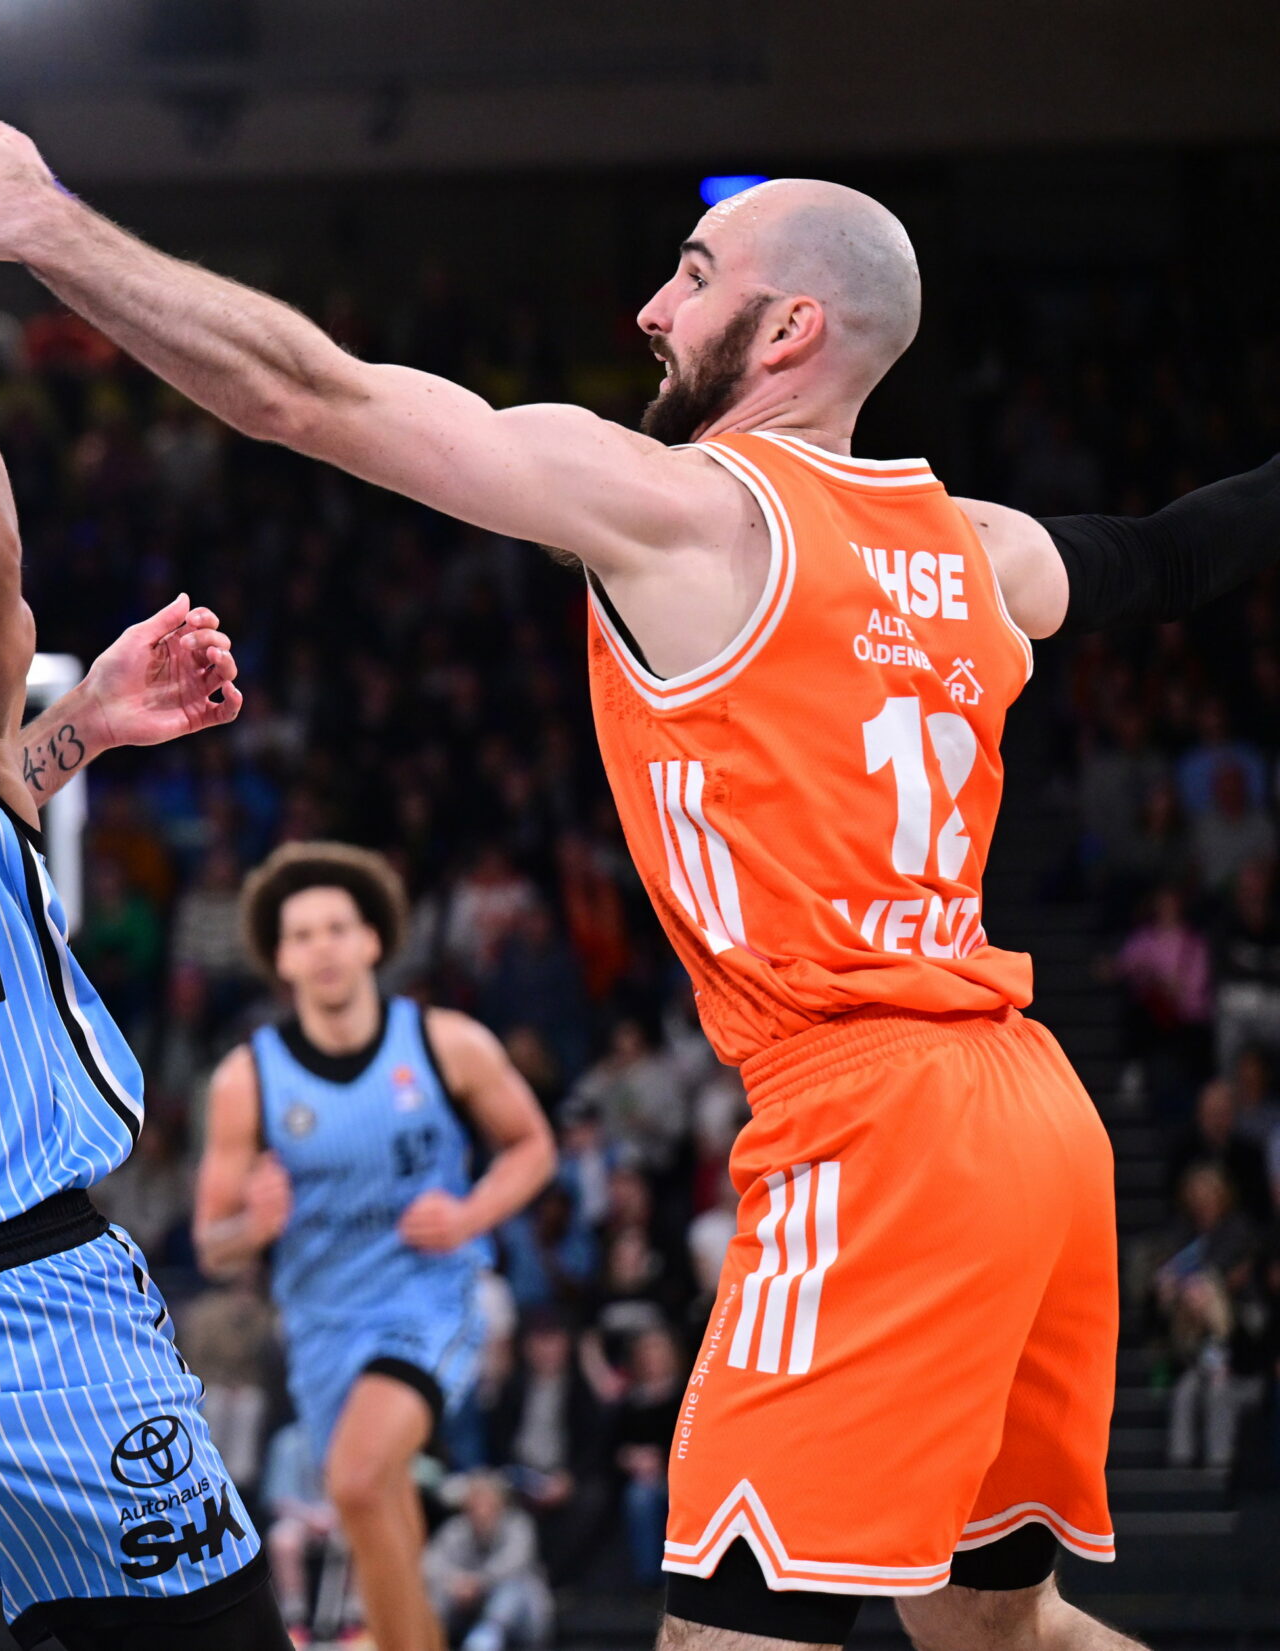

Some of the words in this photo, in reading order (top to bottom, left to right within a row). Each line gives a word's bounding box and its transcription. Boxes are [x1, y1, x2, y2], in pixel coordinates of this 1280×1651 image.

[862, 696, 977, 881] 12
[677, 1392, 700, 1460] meine
[119, 1477, 210, 1525] Autohaus
[120, 1482, 246, 1580] S+K
